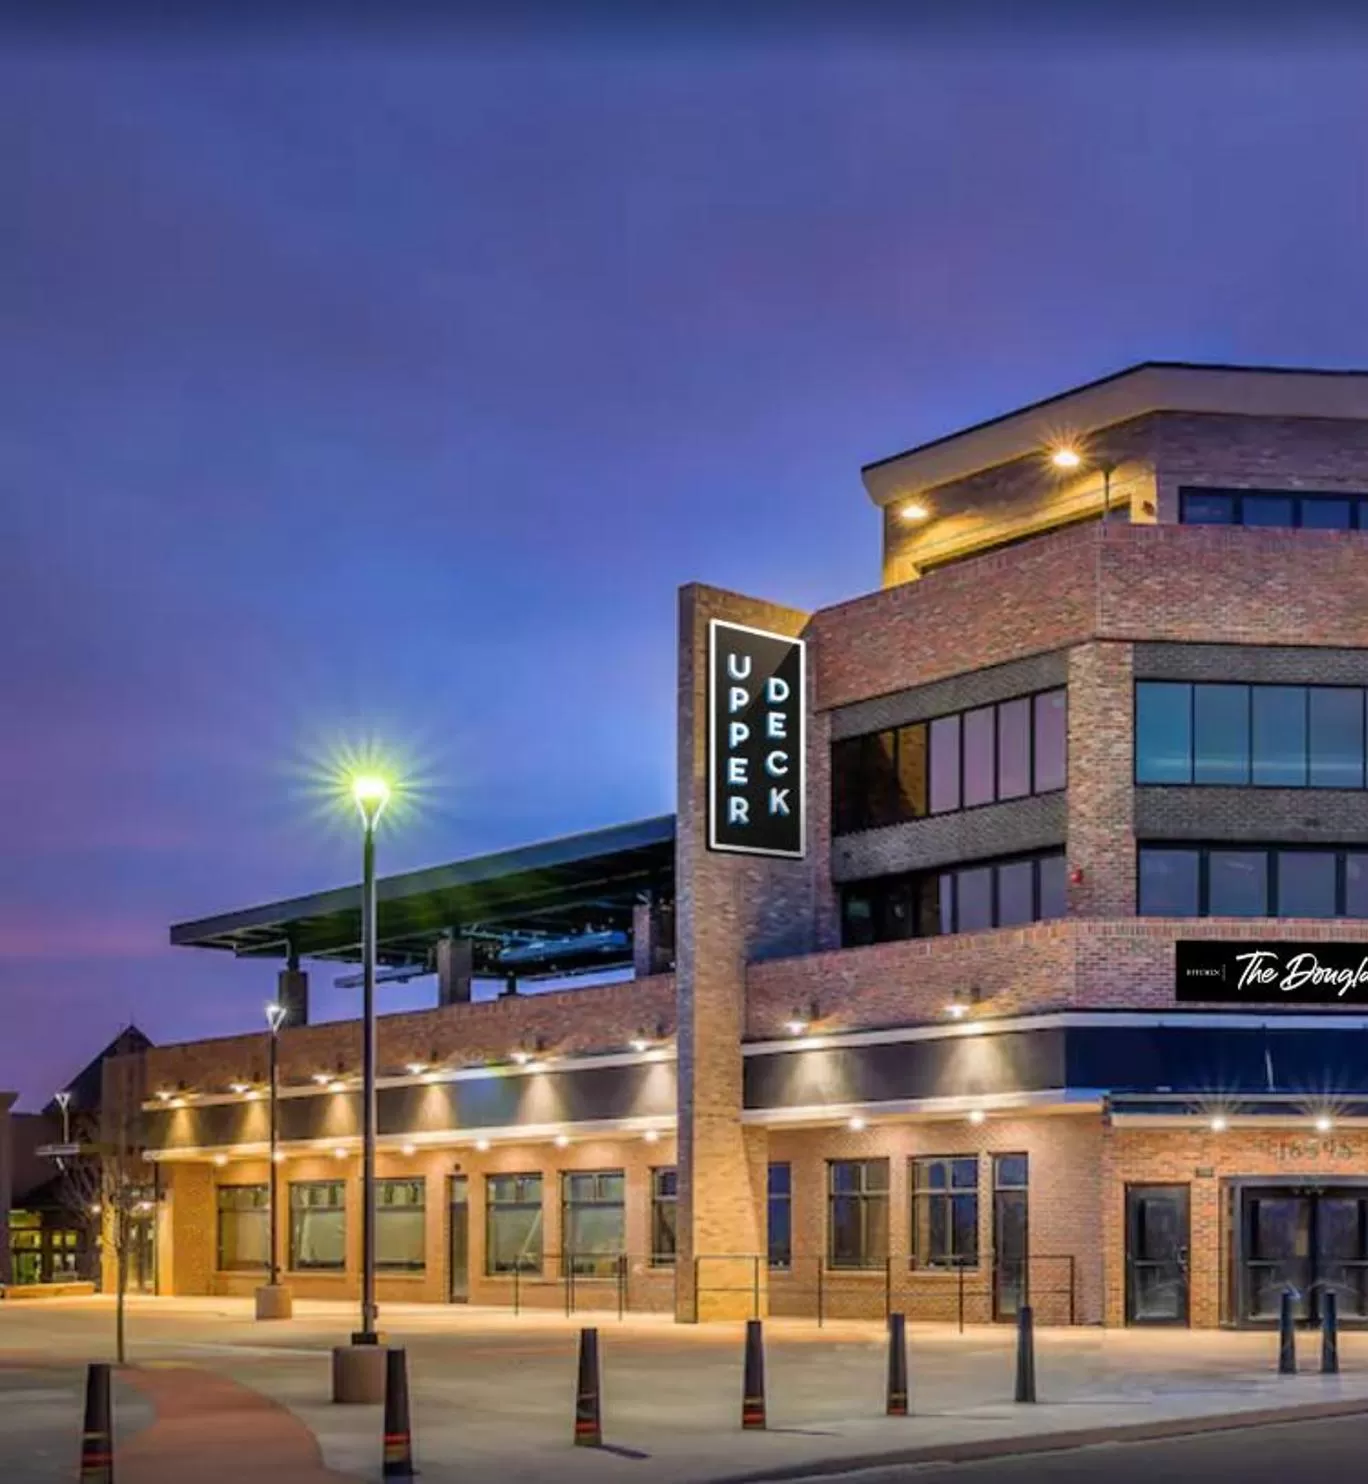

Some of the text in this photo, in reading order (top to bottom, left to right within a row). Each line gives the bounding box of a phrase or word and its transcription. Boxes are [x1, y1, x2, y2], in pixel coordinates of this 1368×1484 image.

[727, 652, 751, 826] UPPER
[765, 676, 790, 816] DECK
[1235, 950, 1279, 991] The
